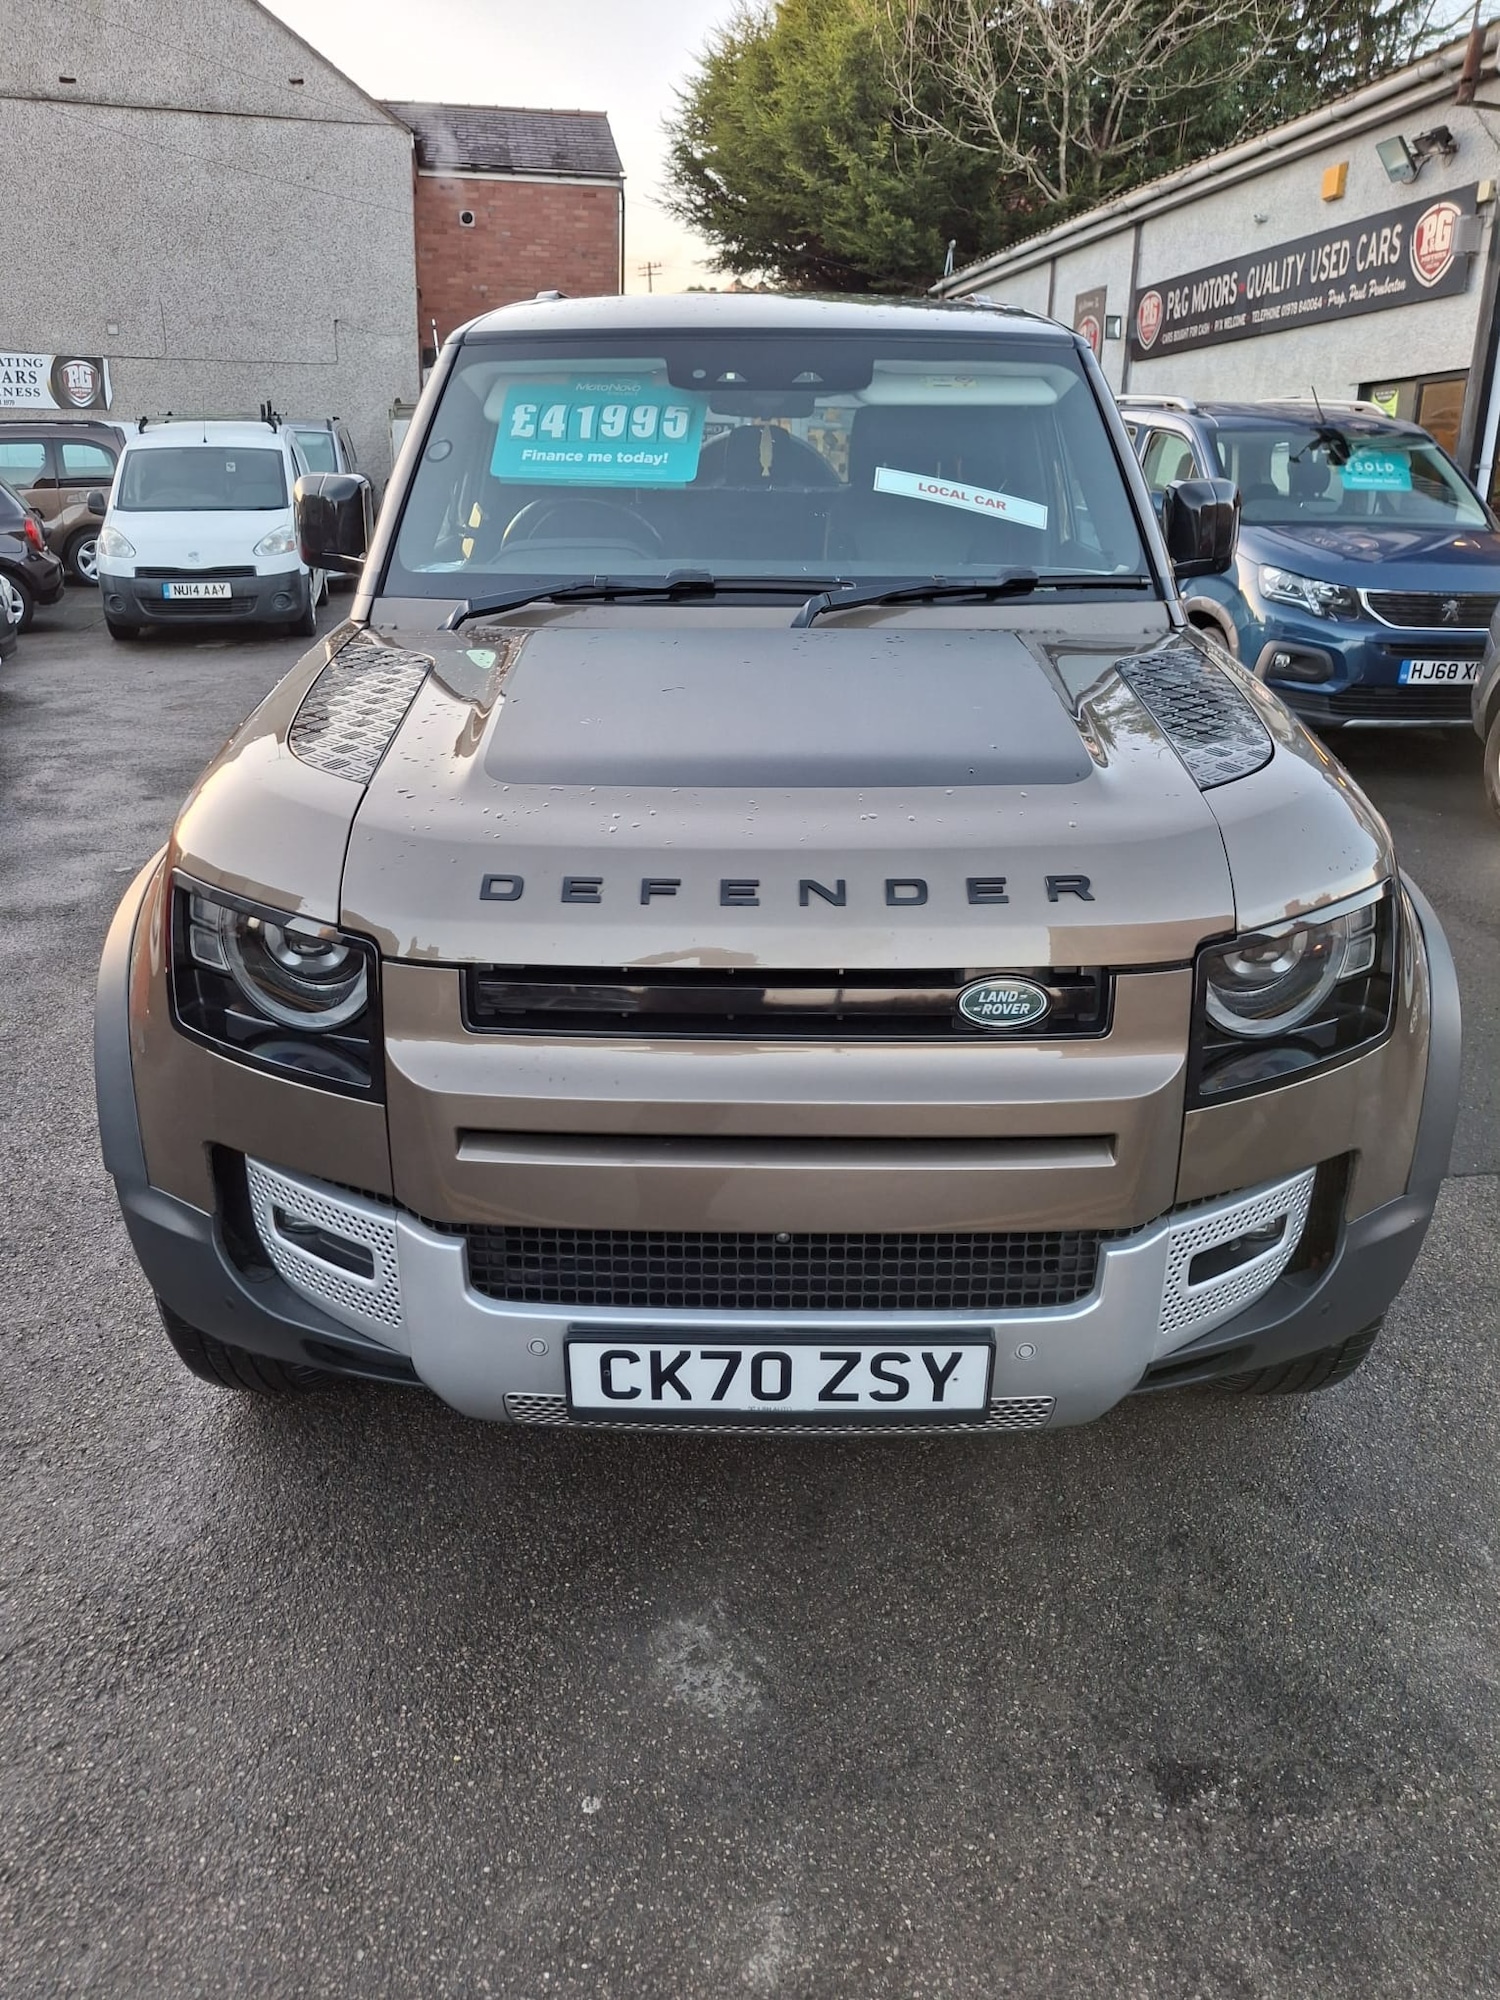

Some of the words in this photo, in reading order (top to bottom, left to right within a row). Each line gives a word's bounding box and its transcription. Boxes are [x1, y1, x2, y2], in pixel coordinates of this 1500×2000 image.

[1166, 286, 1189, 320] P&G
[1191, 271, 1238, 313] MOTORS
[1247, 252, 1306, 299] QUALITY
[1310, 240, 1350, 283] USED
[1356, 223, 1402, 272] CARS
[1252, 305, 1281, 323] TELEPHONE
[1349, 283, 1367, 302] Paul
[510, 404, 689, 439] £41995
[522, 449, 584, 462] Finance
[587, 453, 612, 463] me
[617, 452, 668, 466] today!
[918, 482, 969, 501] LOCAL
[974, 495, 1006, 510] CAR
[173, 584, 199, 596] NU14
[204, 584, 226, 596] AAY
[1411, 662, 1459, 679] HJ68
[479, 873, 1095, 907] DEFENDER
[599, 1348, 793, 1402] CK70
[818, 1350, 964, 1404] ZSY
